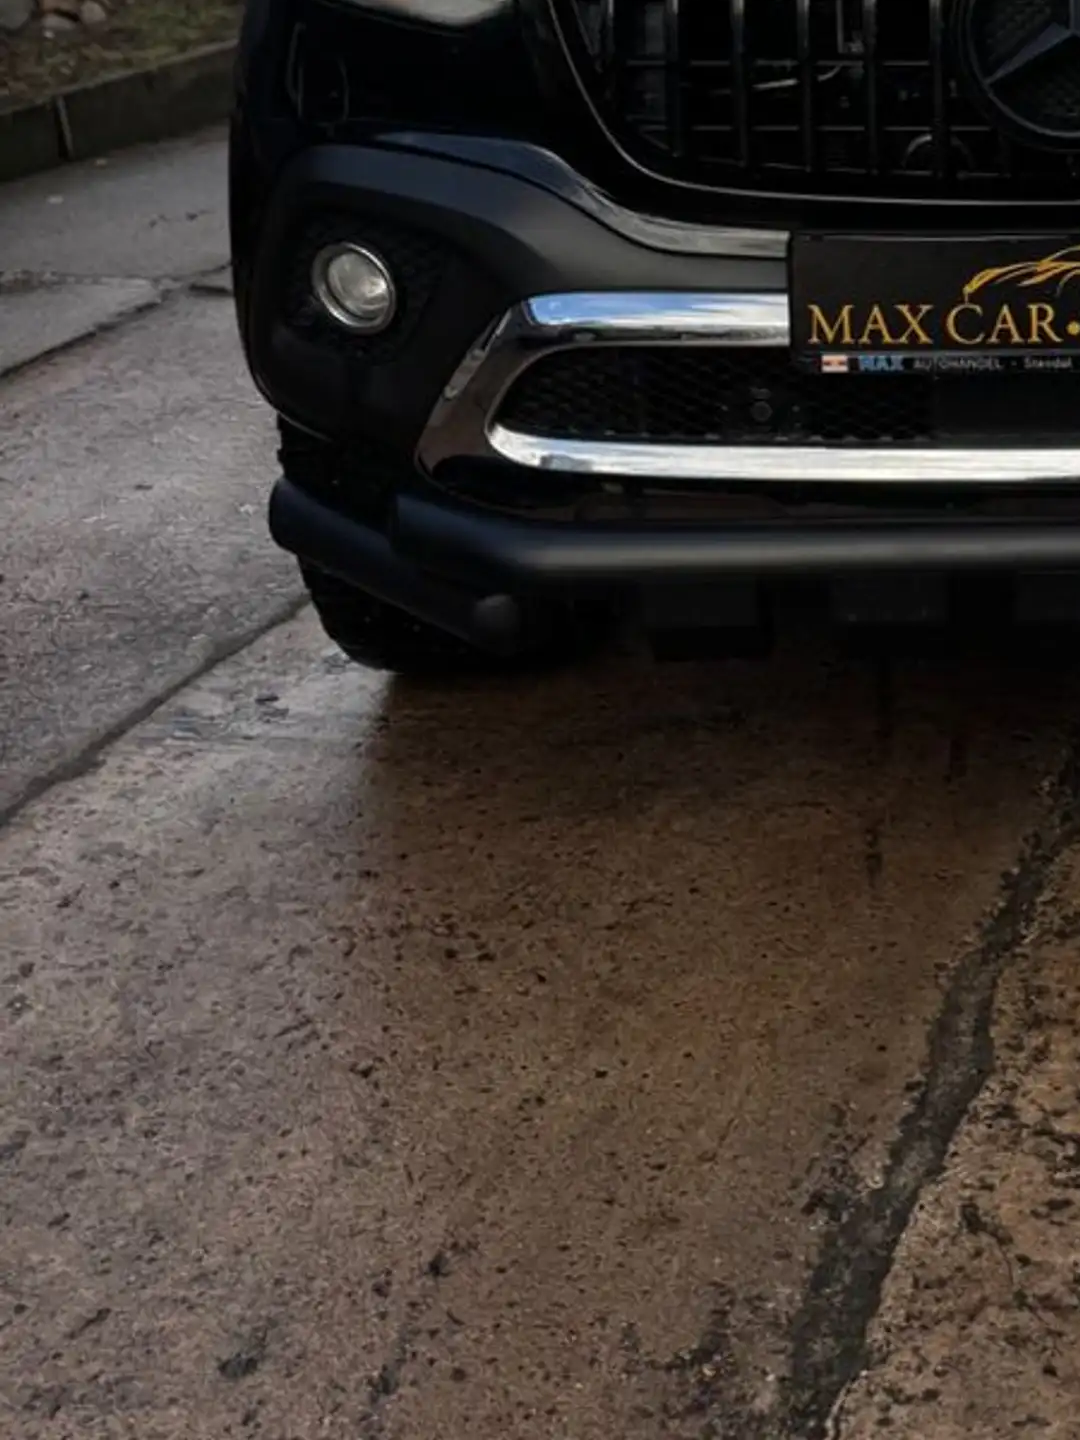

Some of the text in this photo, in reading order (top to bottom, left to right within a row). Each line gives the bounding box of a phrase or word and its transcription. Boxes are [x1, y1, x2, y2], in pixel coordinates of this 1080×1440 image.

[808, 303, 934, 346] MAX
[945, 302, 1062, 345] CAR
[858, 355, 904, 371] MAX
